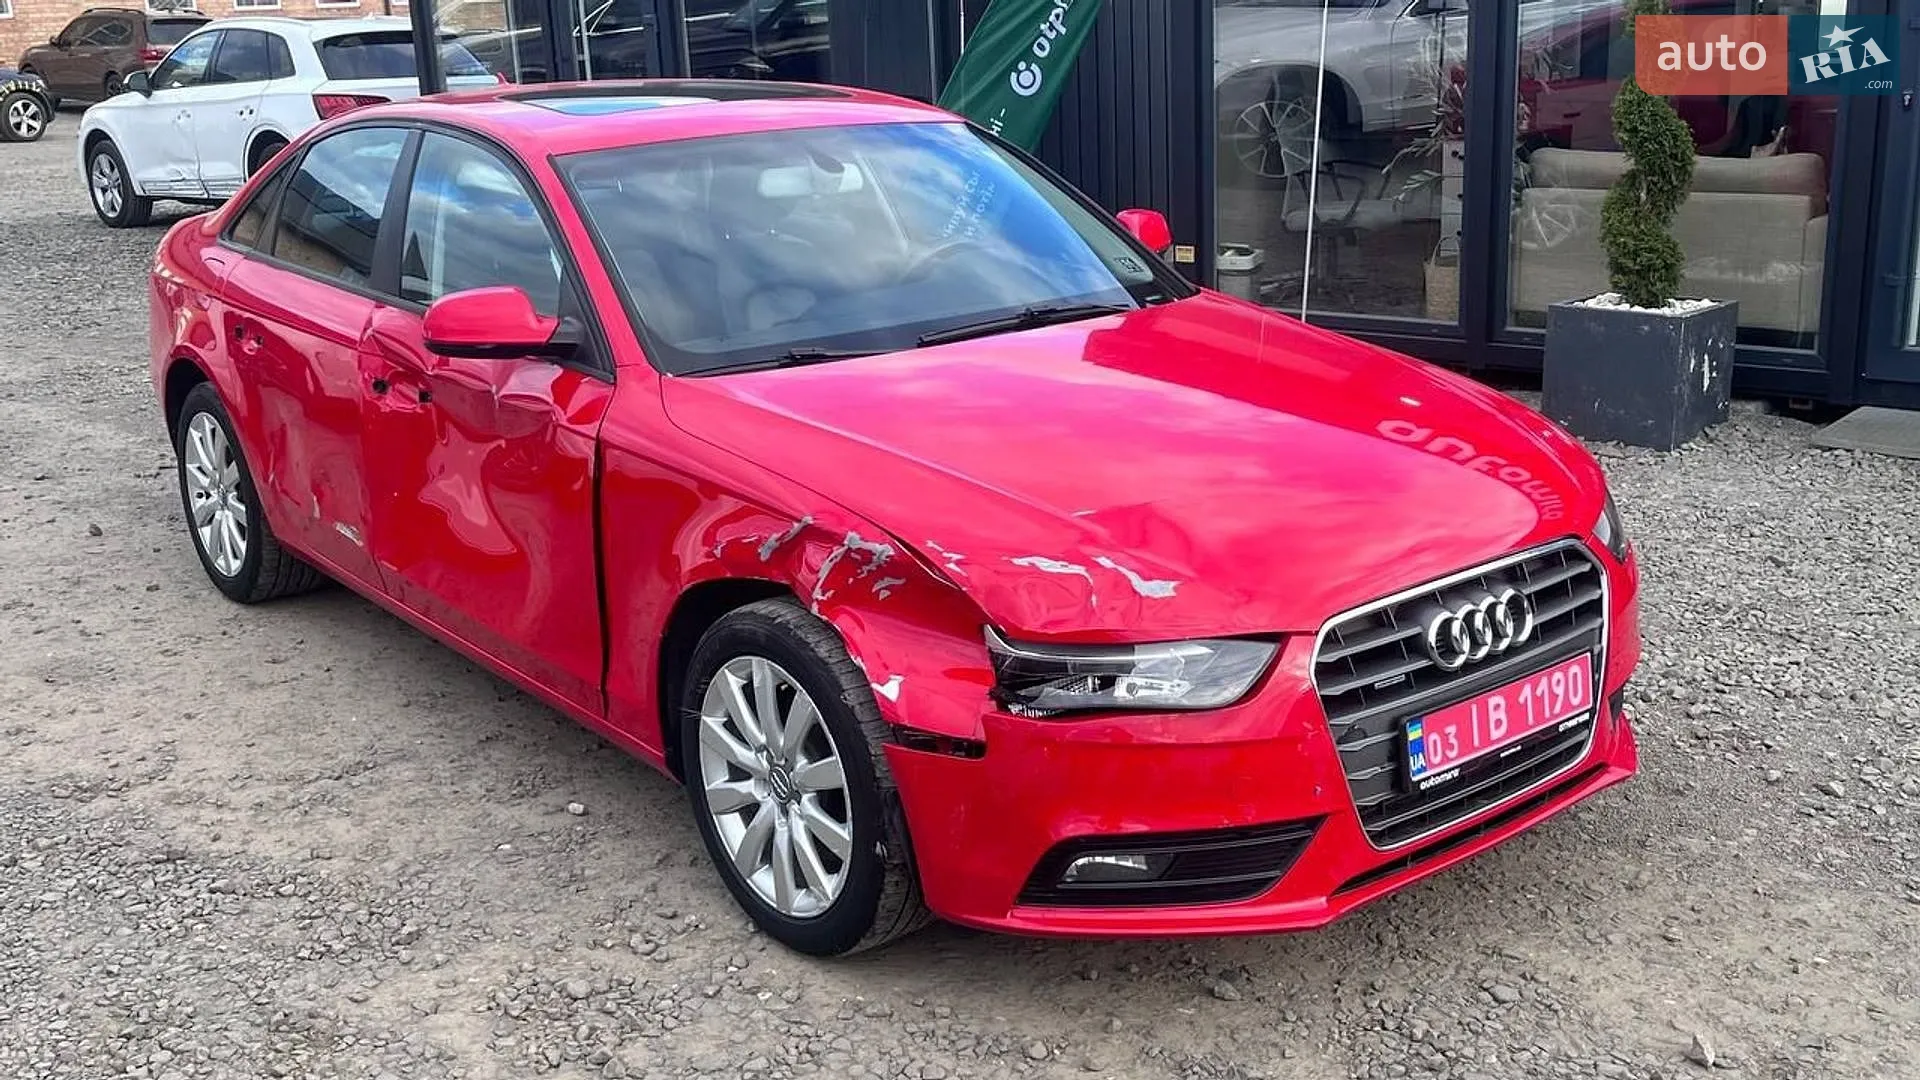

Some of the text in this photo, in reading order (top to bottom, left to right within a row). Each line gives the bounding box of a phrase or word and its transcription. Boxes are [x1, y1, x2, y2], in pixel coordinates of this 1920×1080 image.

[1427, 664, 1583, 765] 03 IB 1190
[1410, 755, 1426, 771] UA
